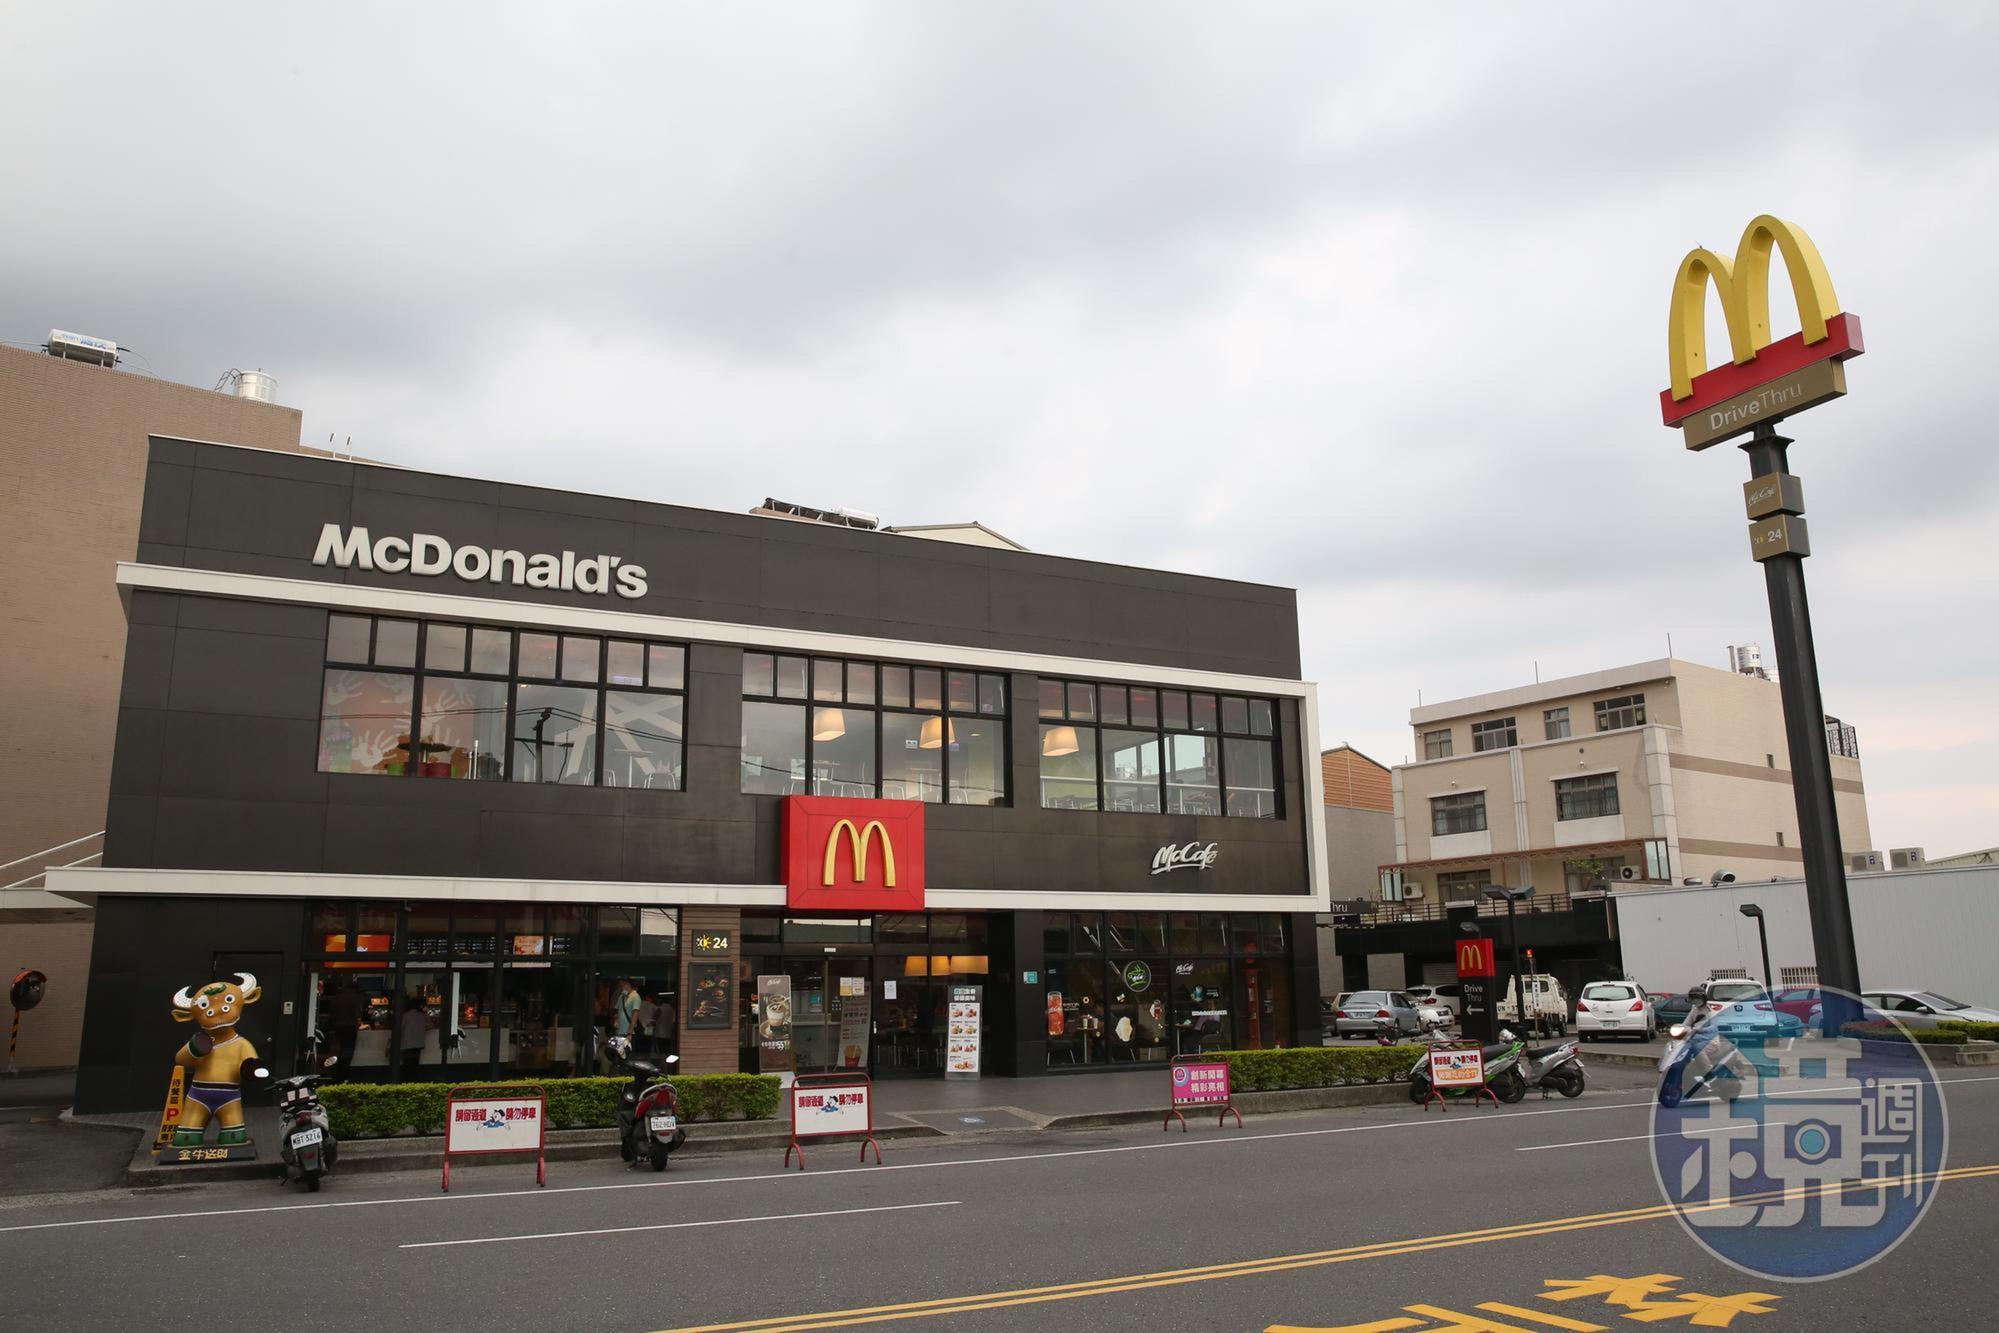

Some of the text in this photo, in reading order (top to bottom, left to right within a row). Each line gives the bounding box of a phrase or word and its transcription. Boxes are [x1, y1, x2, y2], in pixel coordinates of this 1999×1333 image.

[1767, 528, 1782, 543] 24
[311, 522, 649, 600] McDonald's
[713, 937, 729, 949] 24
[1463, 984, 1483, 993] Drive
[1467, 993, 1482, 1002] Thru
[166, 1107, 180, 1121] P
[178, 1148, 229, 1161] 金牛送財
